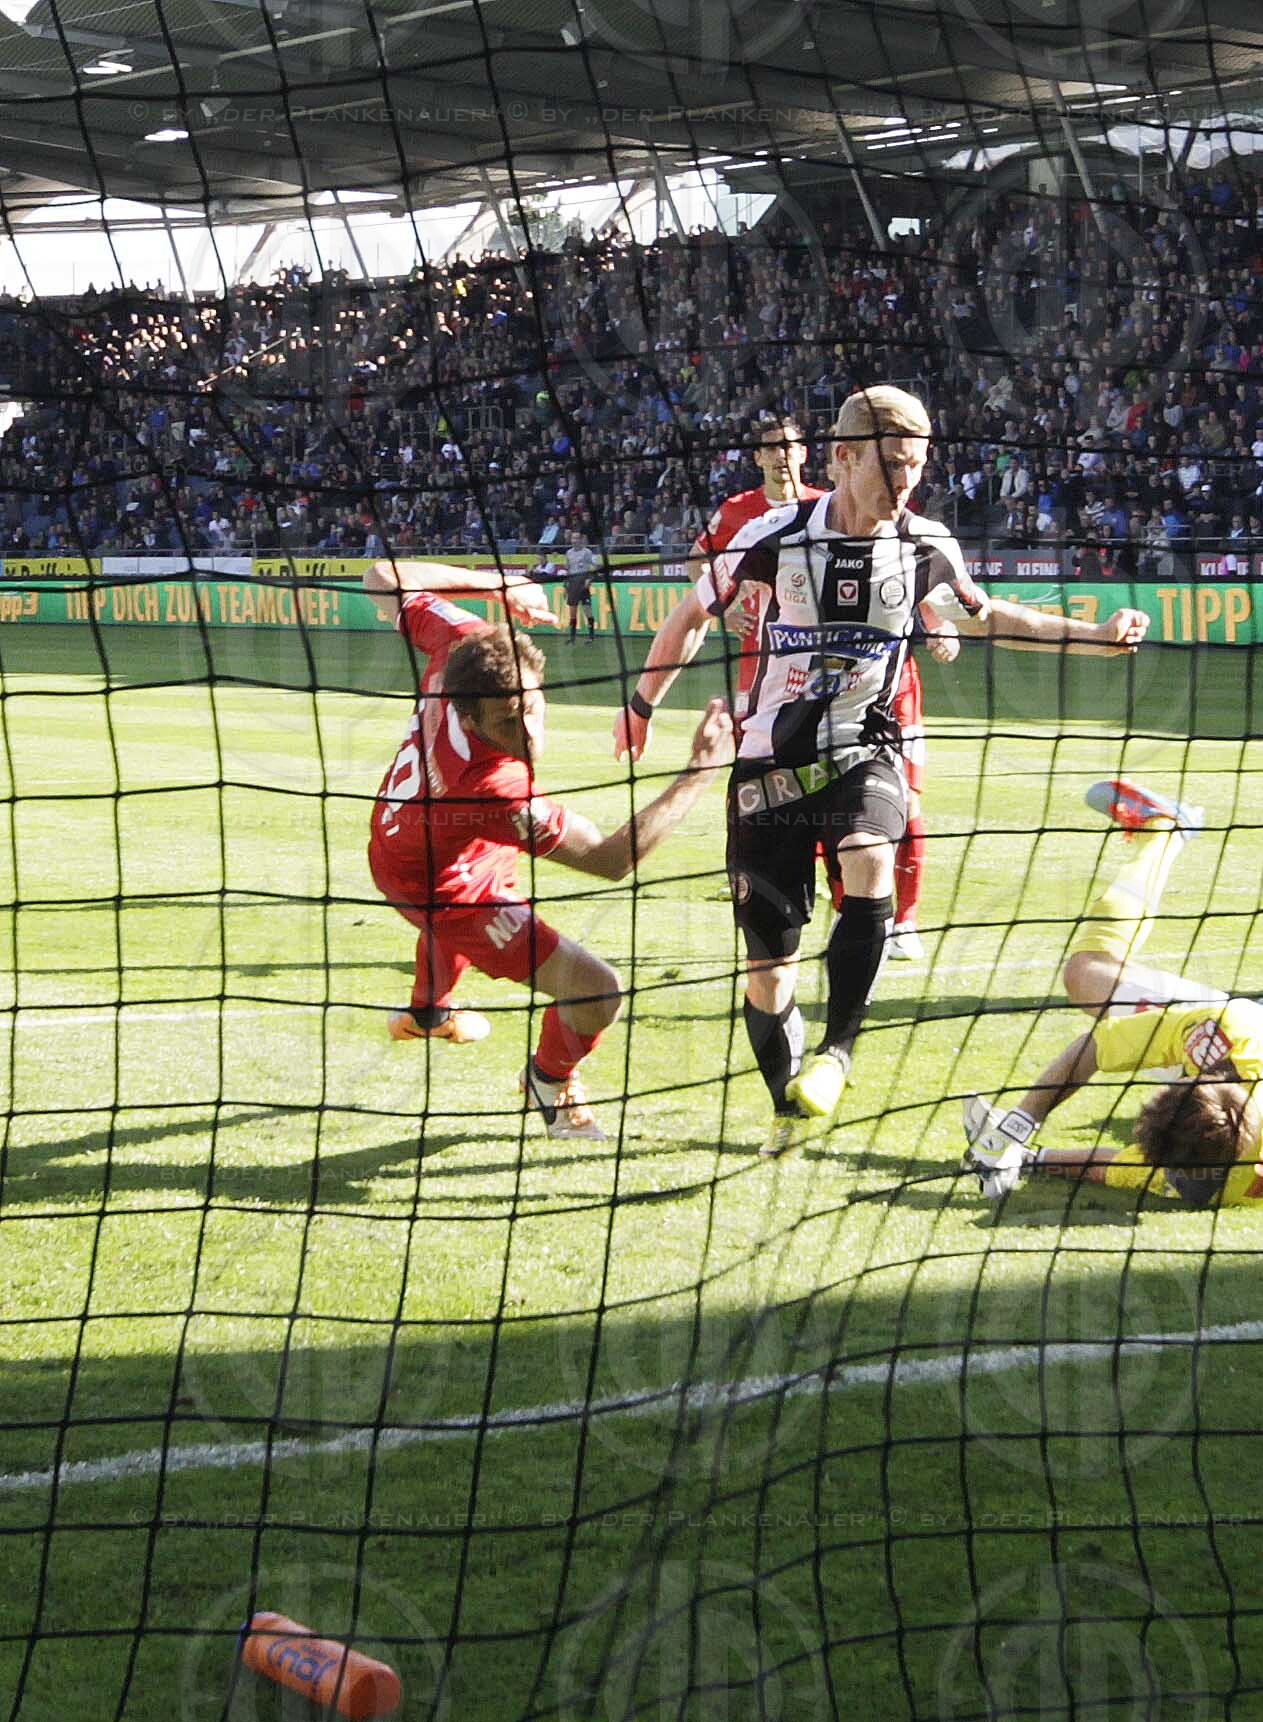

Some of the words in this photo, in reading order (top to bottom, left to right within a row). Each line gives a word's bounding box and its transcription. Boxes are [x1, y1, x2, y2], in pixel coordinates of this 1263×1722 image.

[834, 558, 864, 569] JAKO
[112, 585, 160, 622] DICH
[165, 585, 211, 623] ZUM
[218, 585, 340, 626] TEAMCHEF!
[1157, 588, 1251, 642] TIPP
